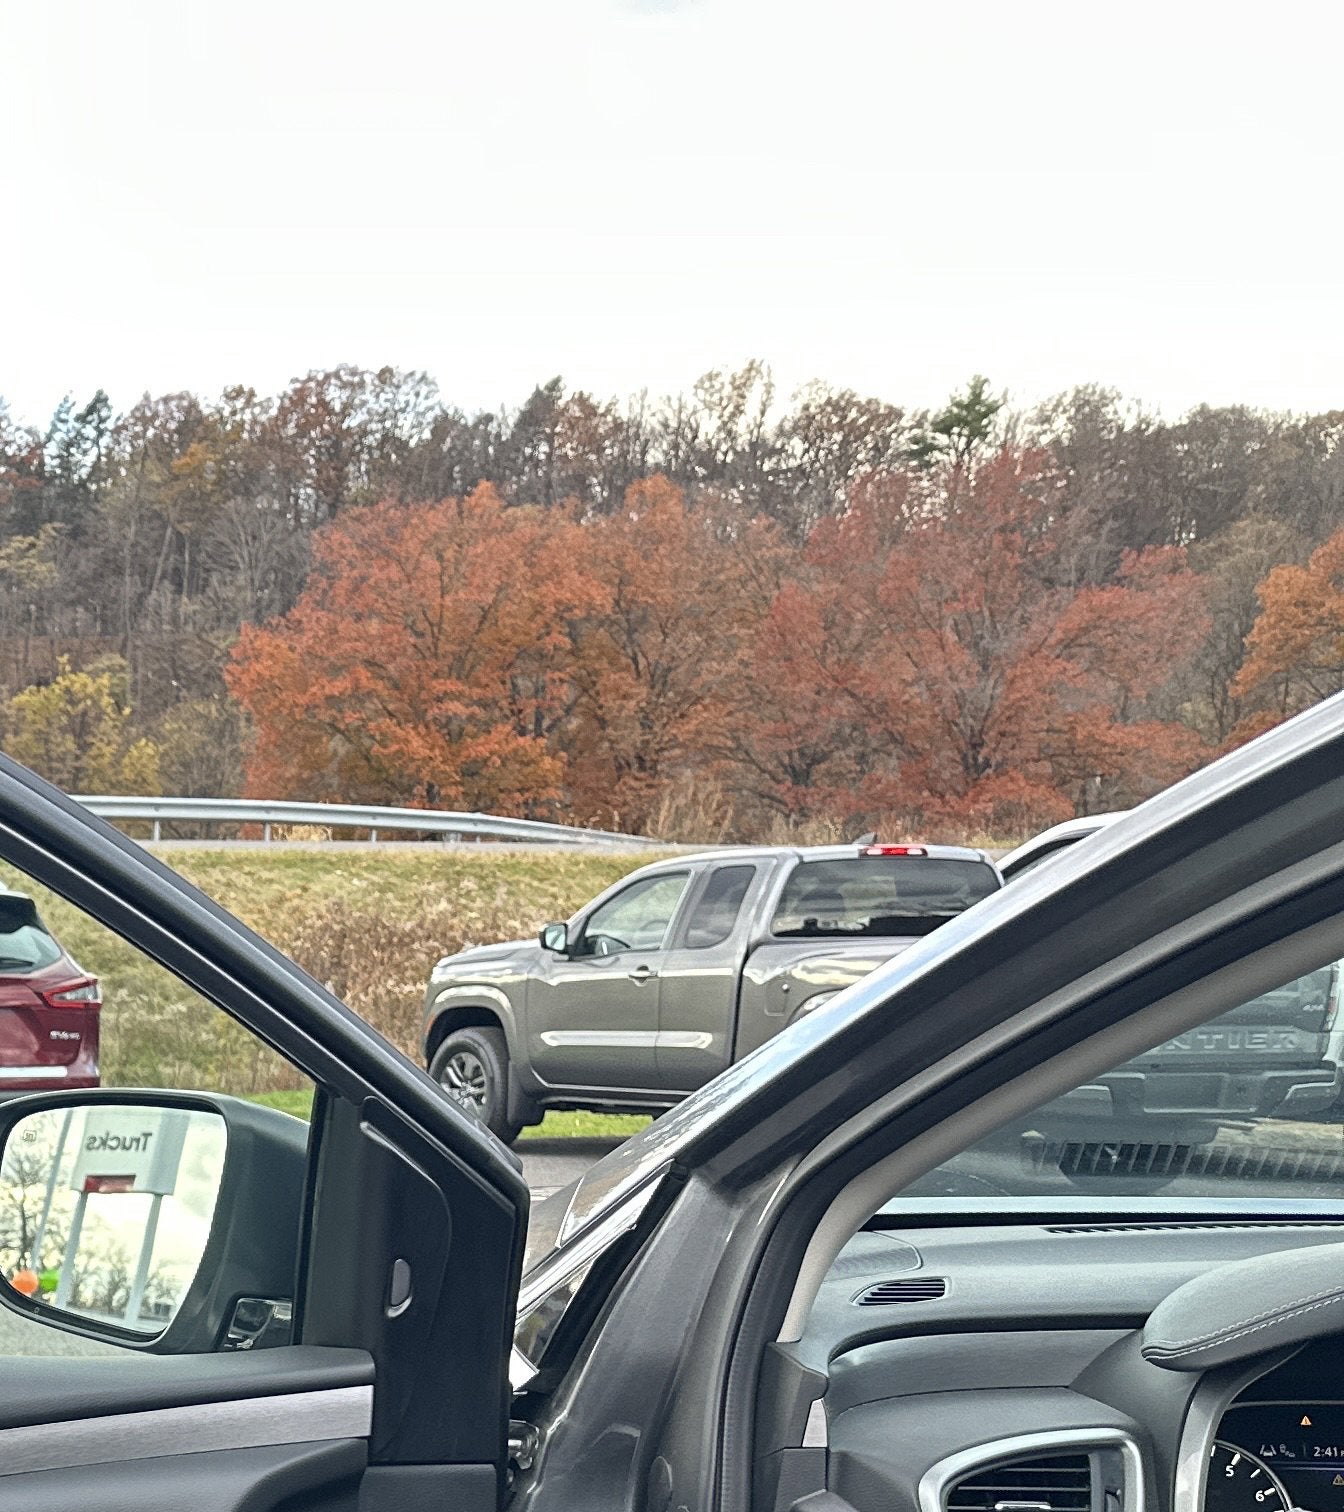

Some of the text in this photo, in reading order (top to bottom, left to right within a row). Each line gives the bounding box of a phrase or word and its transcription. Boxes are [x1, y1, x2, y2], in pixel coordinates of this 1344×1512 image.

[1166, 1032, 1296, 1049] NTIER
[1313, 1446, 1338, 1457] 2:41
[1225, 1465, 1235, 1477] 5
[1255, 1490, 1265, 1502] 6
